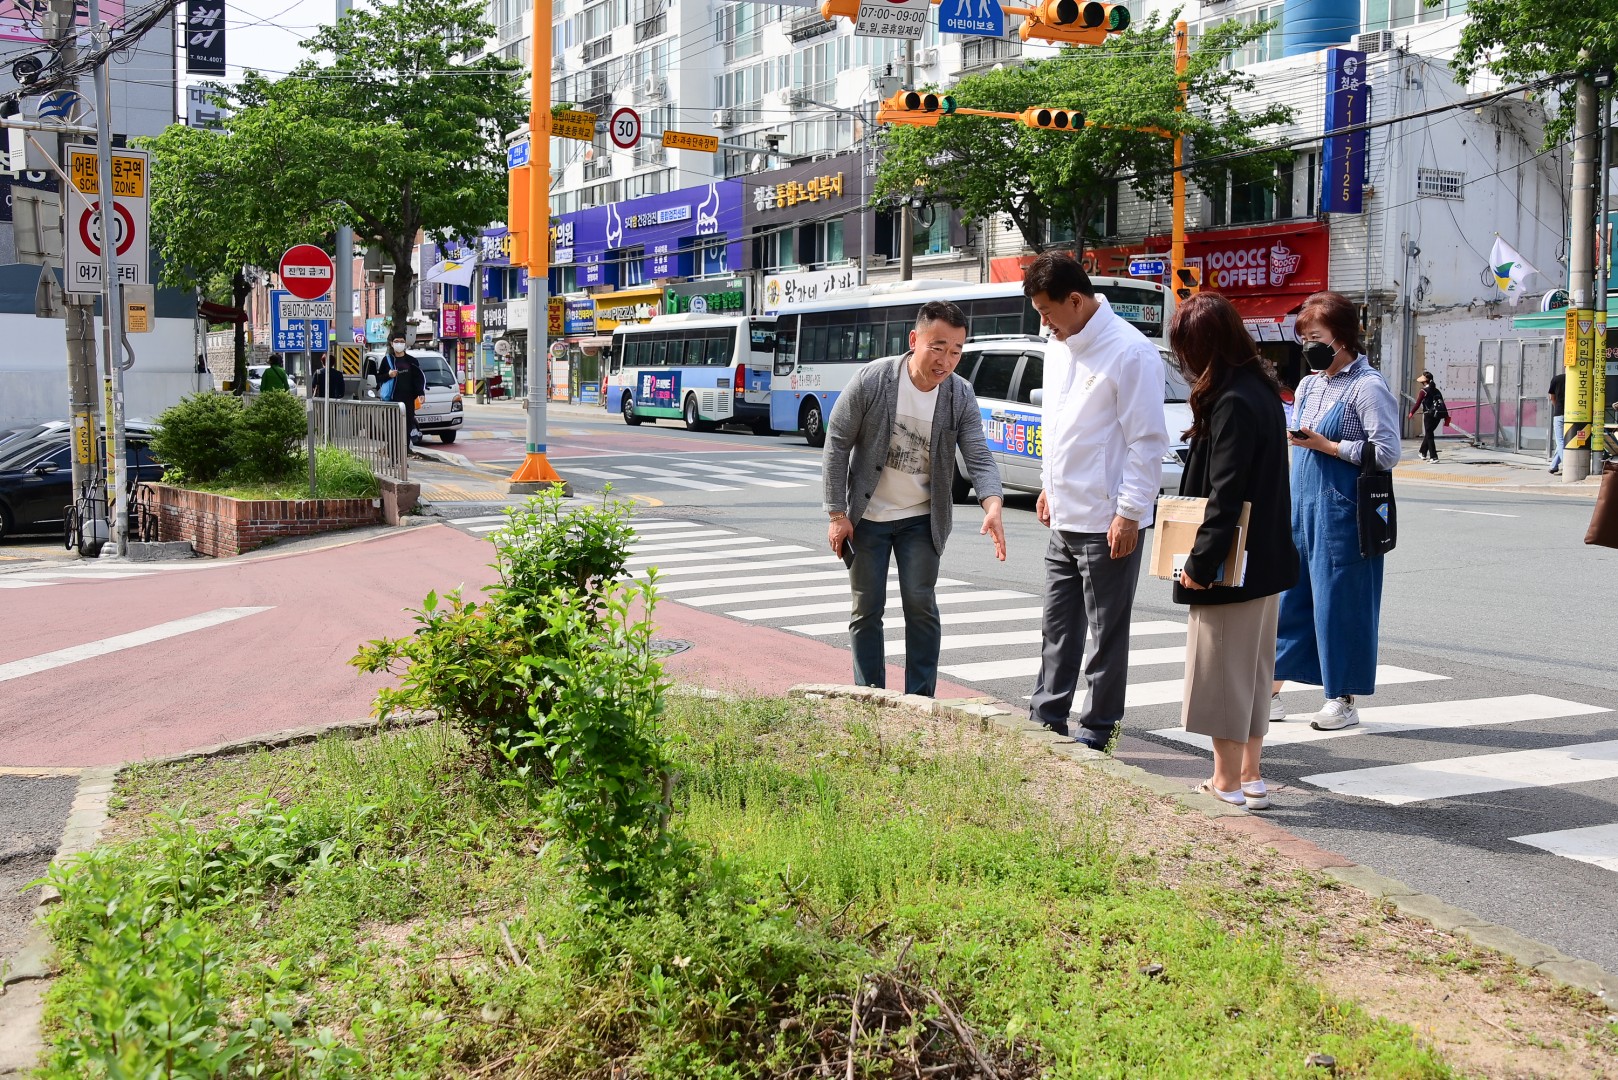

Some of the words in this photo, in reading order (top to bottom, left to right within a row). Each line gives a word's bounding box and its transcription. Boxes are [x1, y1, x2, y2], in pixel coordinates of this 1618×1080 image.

[861, 7, 925, 23] 07:00~09:00
[857, 23, 922, 36] 토,일,공휴일제외
[947, 18, 995, 31] 어린이보호
[1340, 77, 1359, 91] 청춘
[618, 121, 634, 137] 30
[1342, 95, 1353, 201] 71.7125
[75, 156, 141, 181] 어린호구역
[115, 181, 136, 193] ZONE
[1206, 248, 1266, 270] 1000CC
[80, 265, 135, 282] 여기부터
[289, 267, 326, 276] 진입금지
[1209, 267, 1267, 288] COFFEE
[293, 303, 332, 317] 07:00~09:00
[611, 306, 635, 320] PIZZA
[1142, 306, 1160, 321] 189-1
